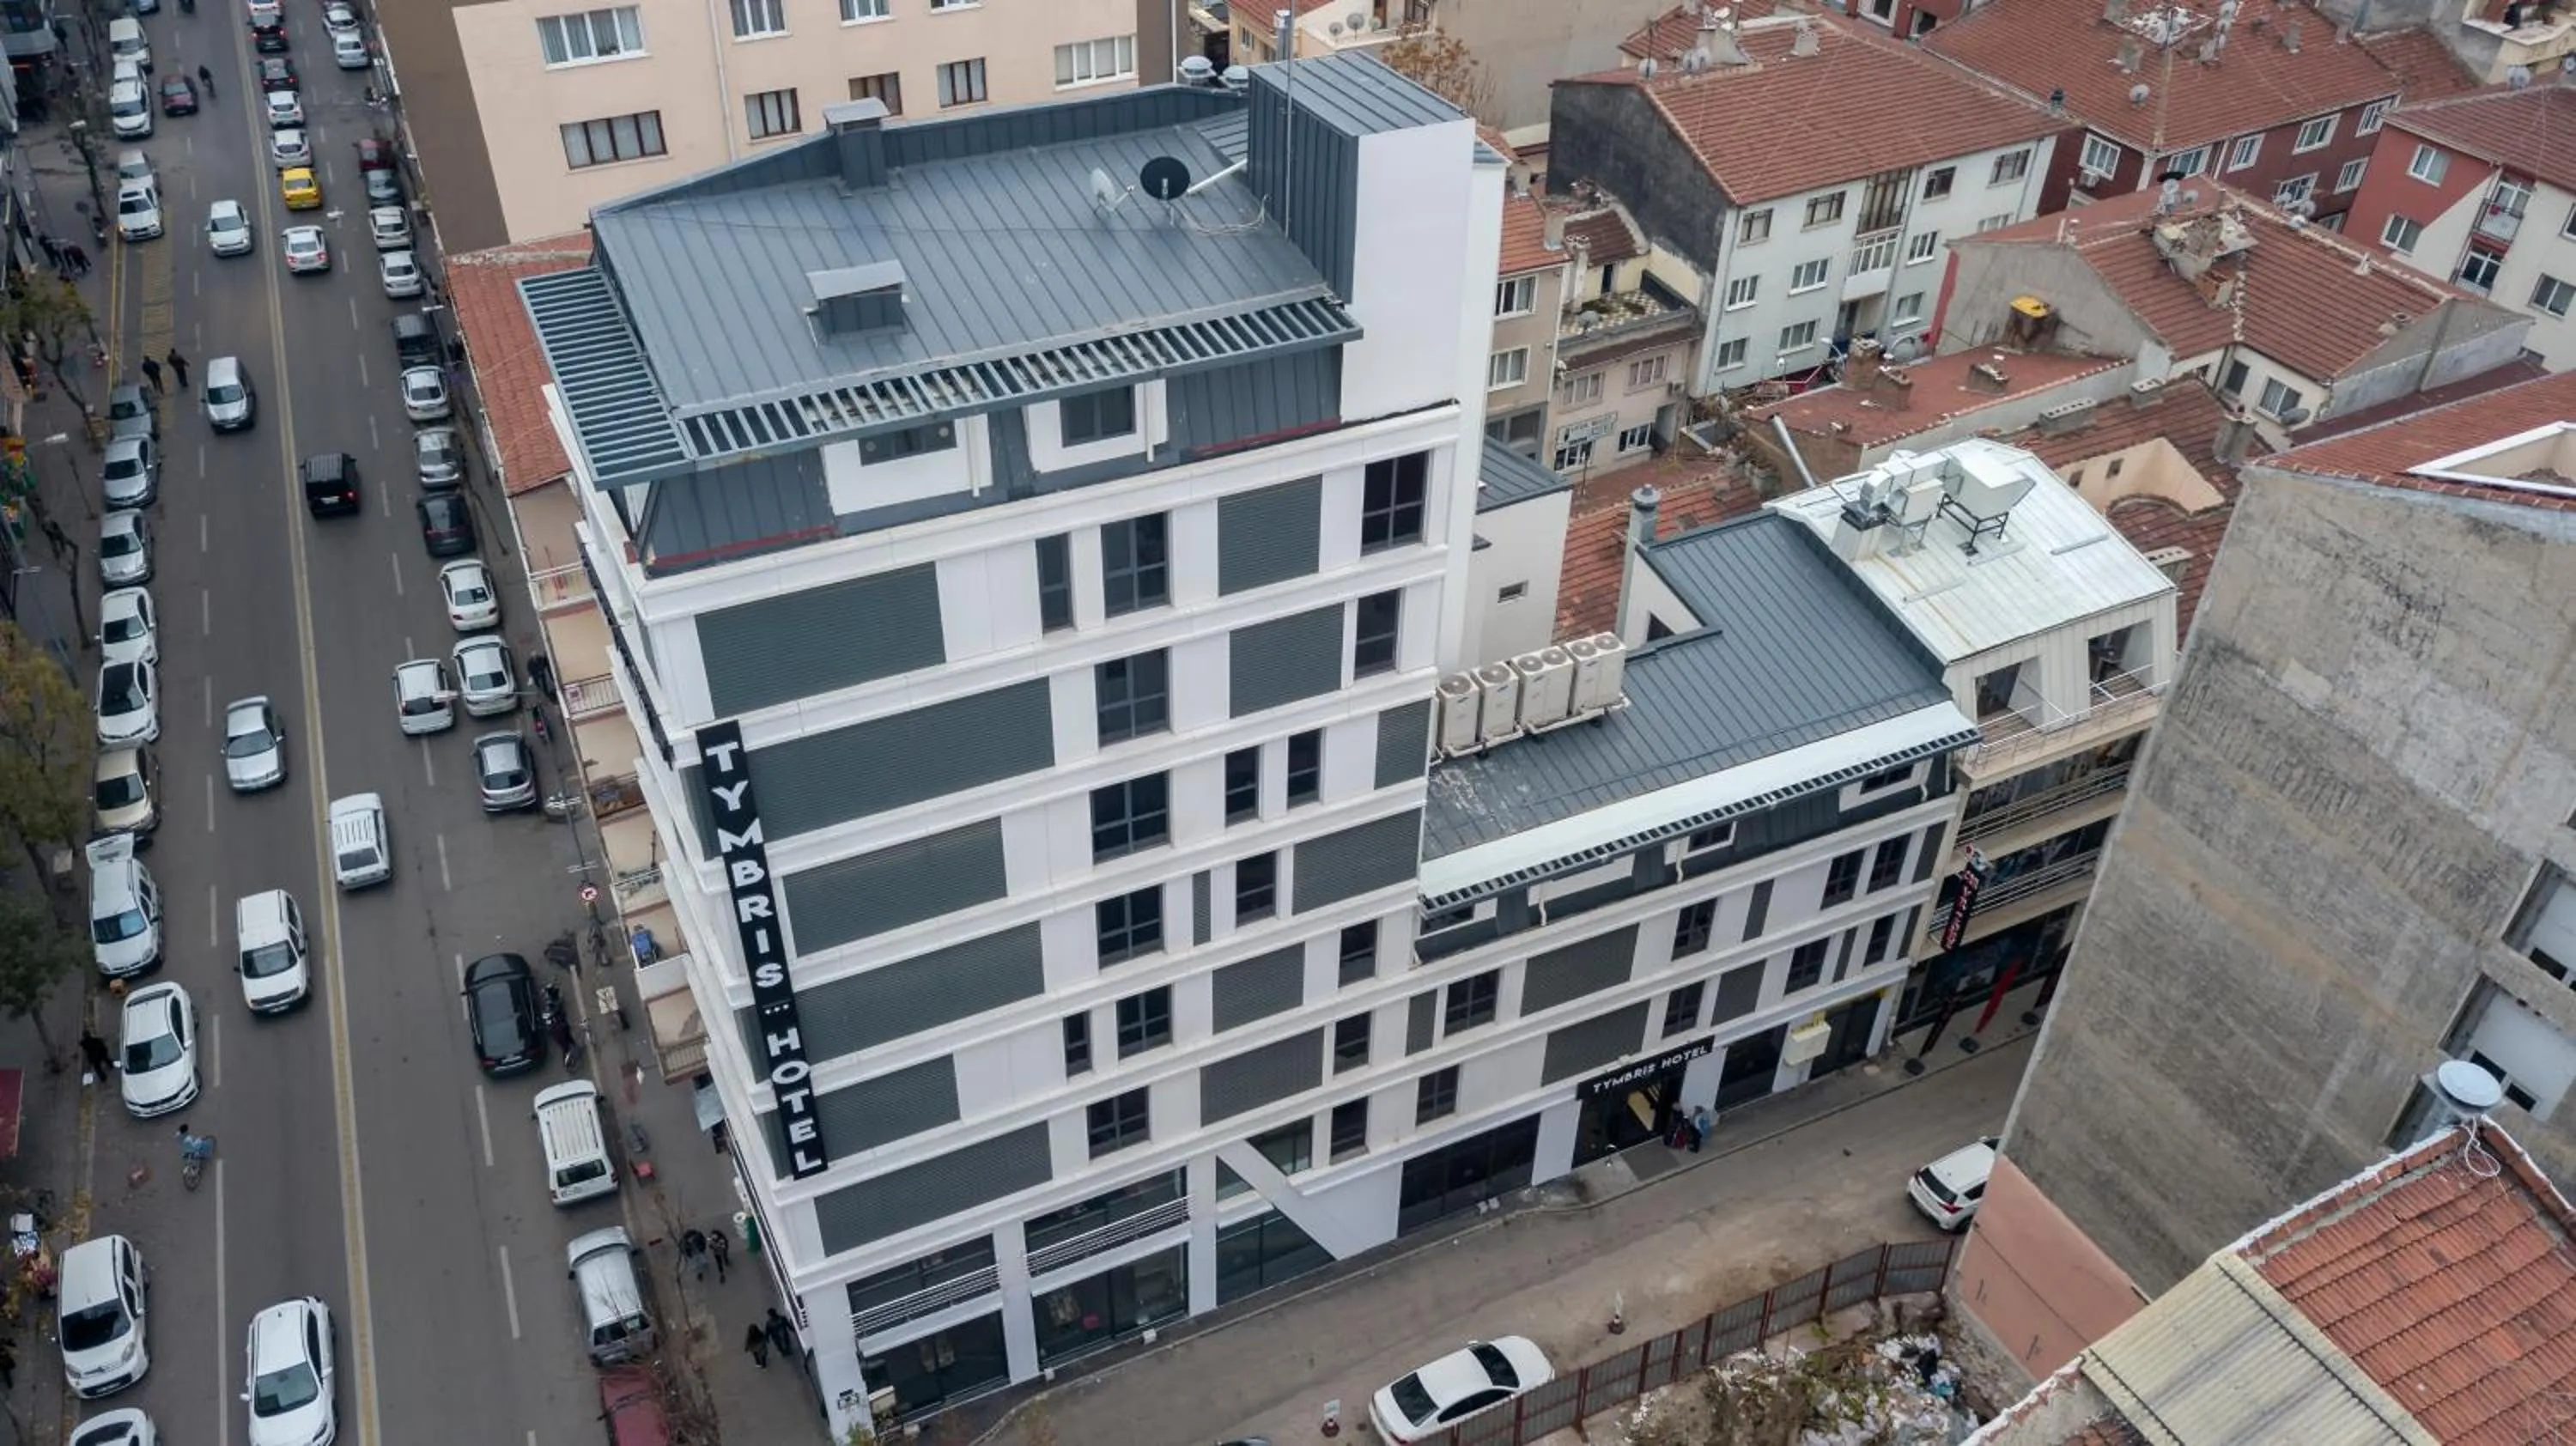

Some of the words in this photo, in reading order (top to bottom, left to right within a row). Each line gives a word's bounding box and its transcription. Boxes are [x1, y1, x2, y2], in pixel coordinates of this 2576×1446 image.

[706, 742, 784, 988] TYMBRIS
[768, 1028, 823, 1173] HOTEL
[1593, 1063, 1656, 1093] TYMBRIS
[1662, 1045, 1707, 1068] HOTEL
